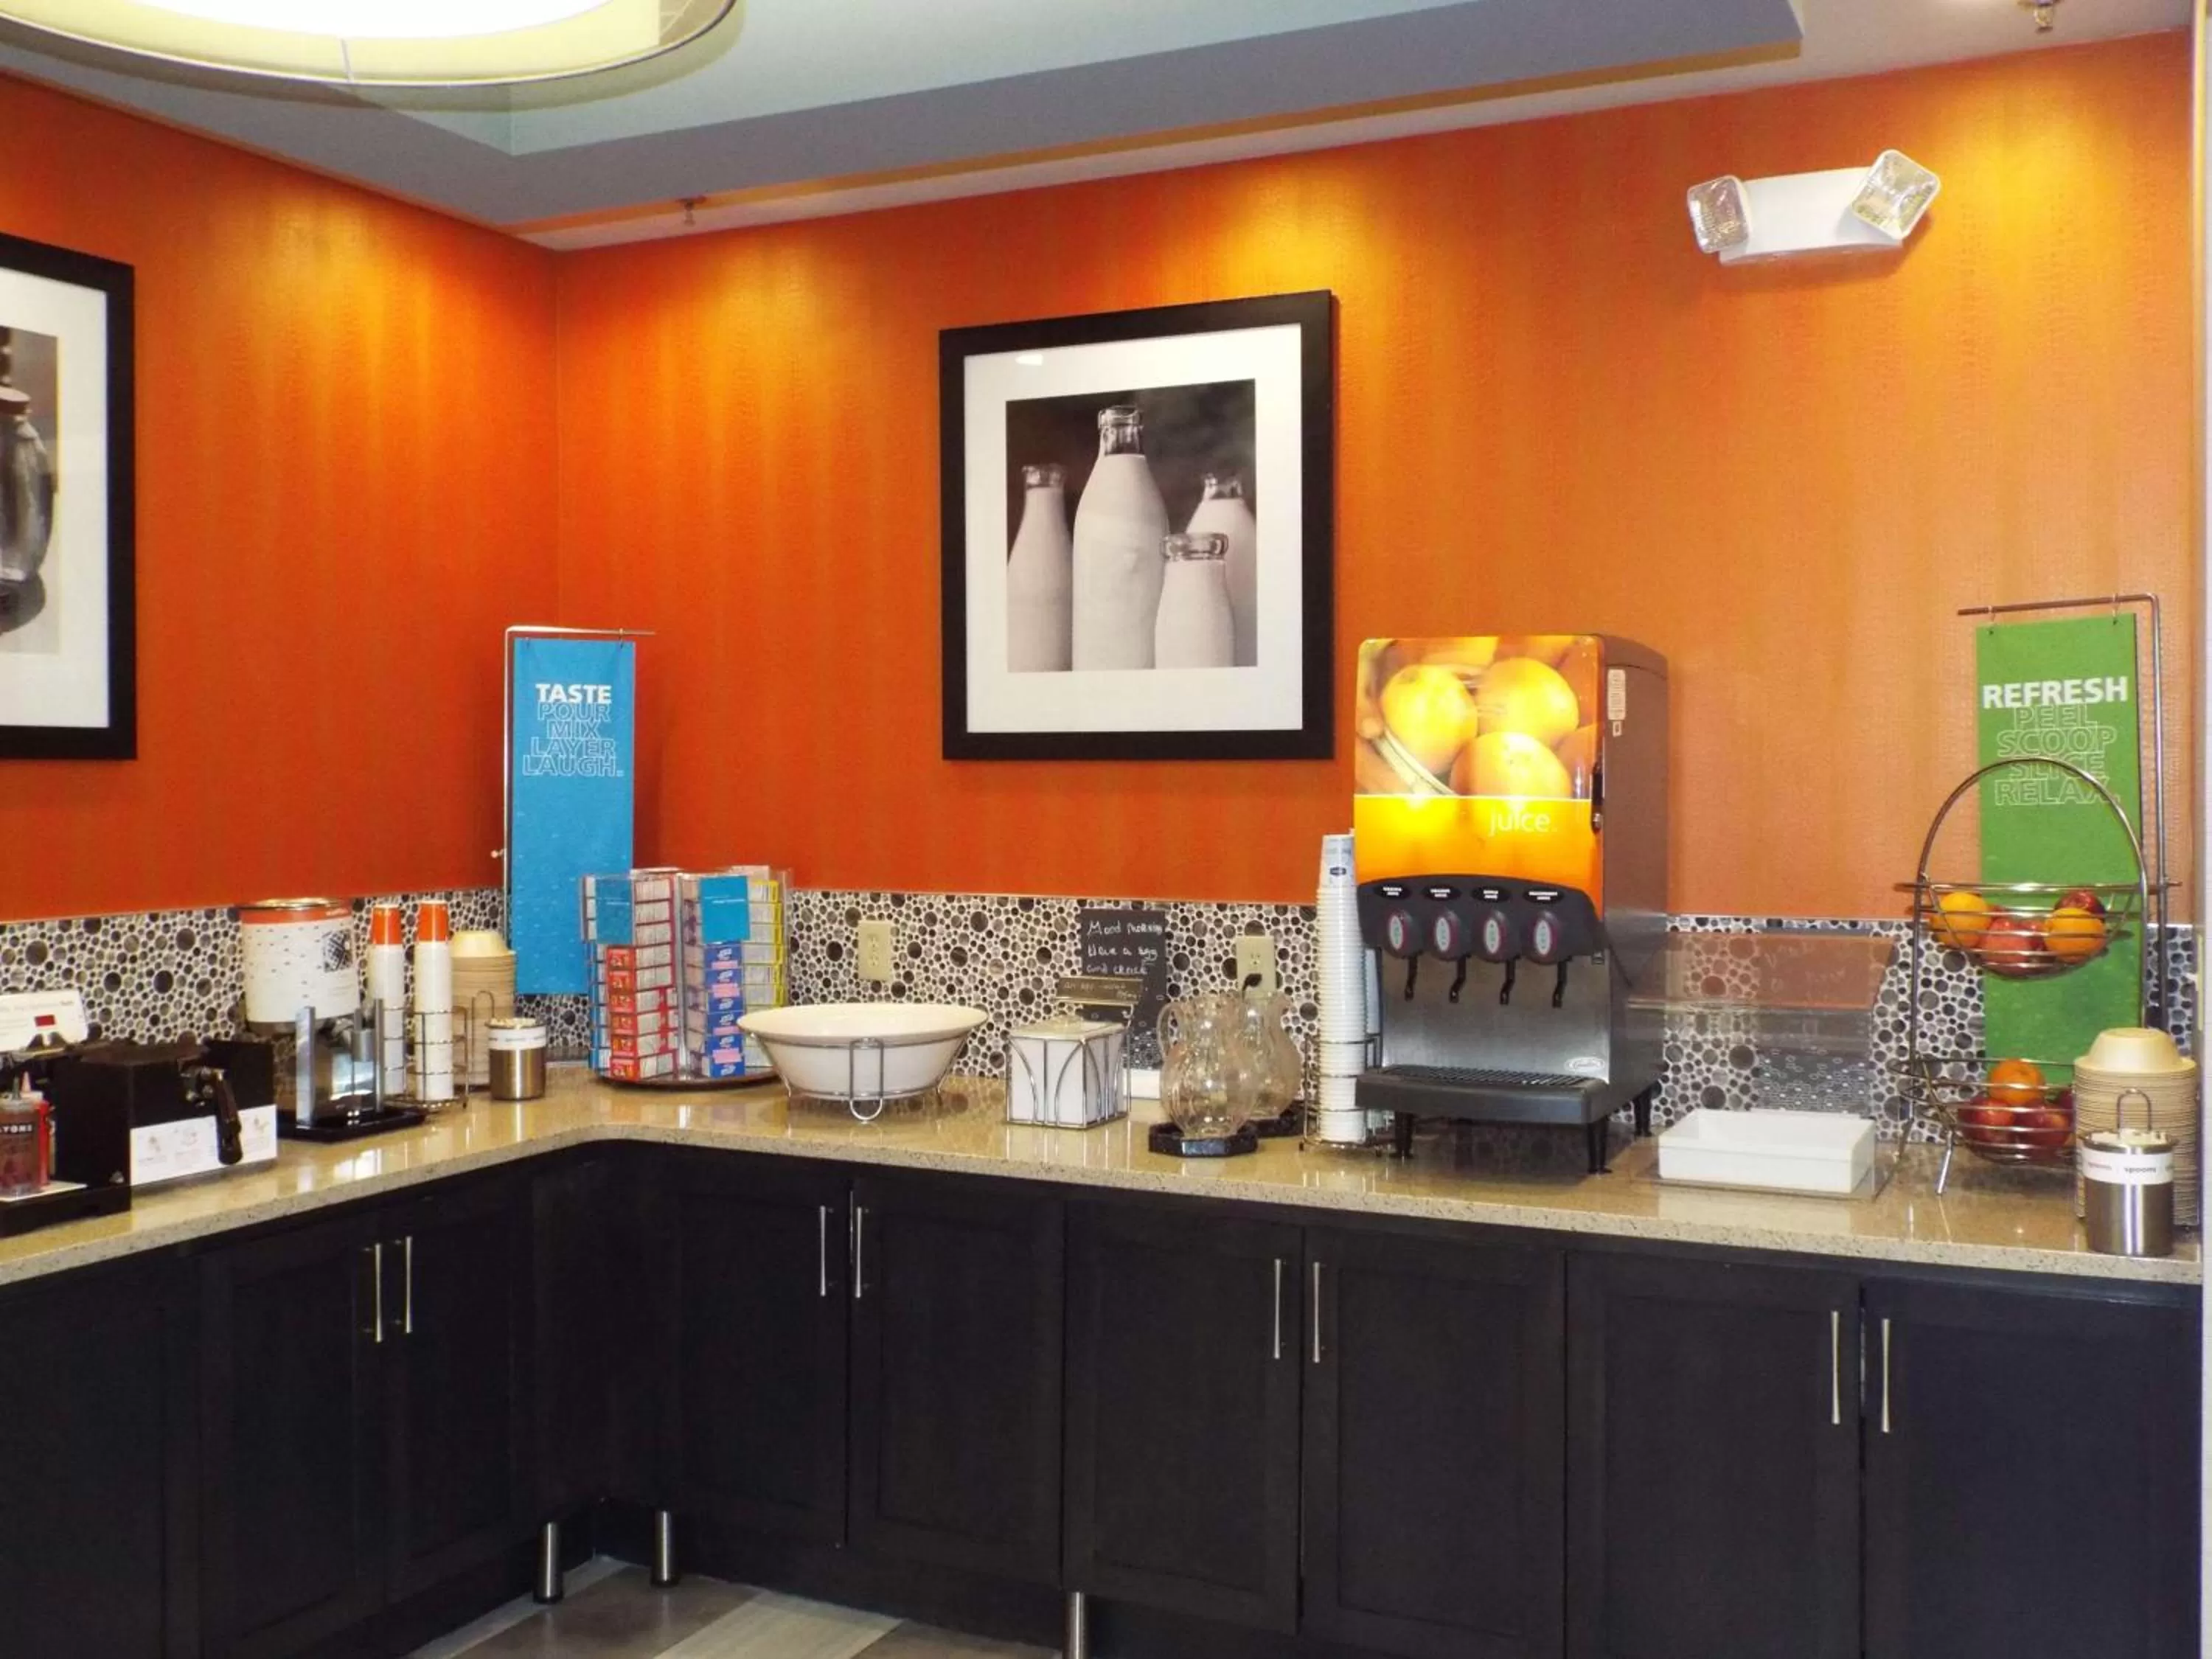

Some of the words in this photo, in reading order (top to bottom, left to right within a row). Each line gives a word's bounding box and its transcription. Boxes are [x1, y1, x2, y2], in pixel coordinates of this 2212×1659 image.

[535, 684, 612, 704] TASTE
[1981, 676, 2129, 709] REFRESH
[538, 701, 611, 722] POUR
[2014, 703, 2098, 731] PEEL
[546, 720, 600, 740] MIX
[530, 737, 616, 759] LAYER
[1997, 726, 2118, 757] SCOOP
[522, 754, 625, 777] LAUGH.
